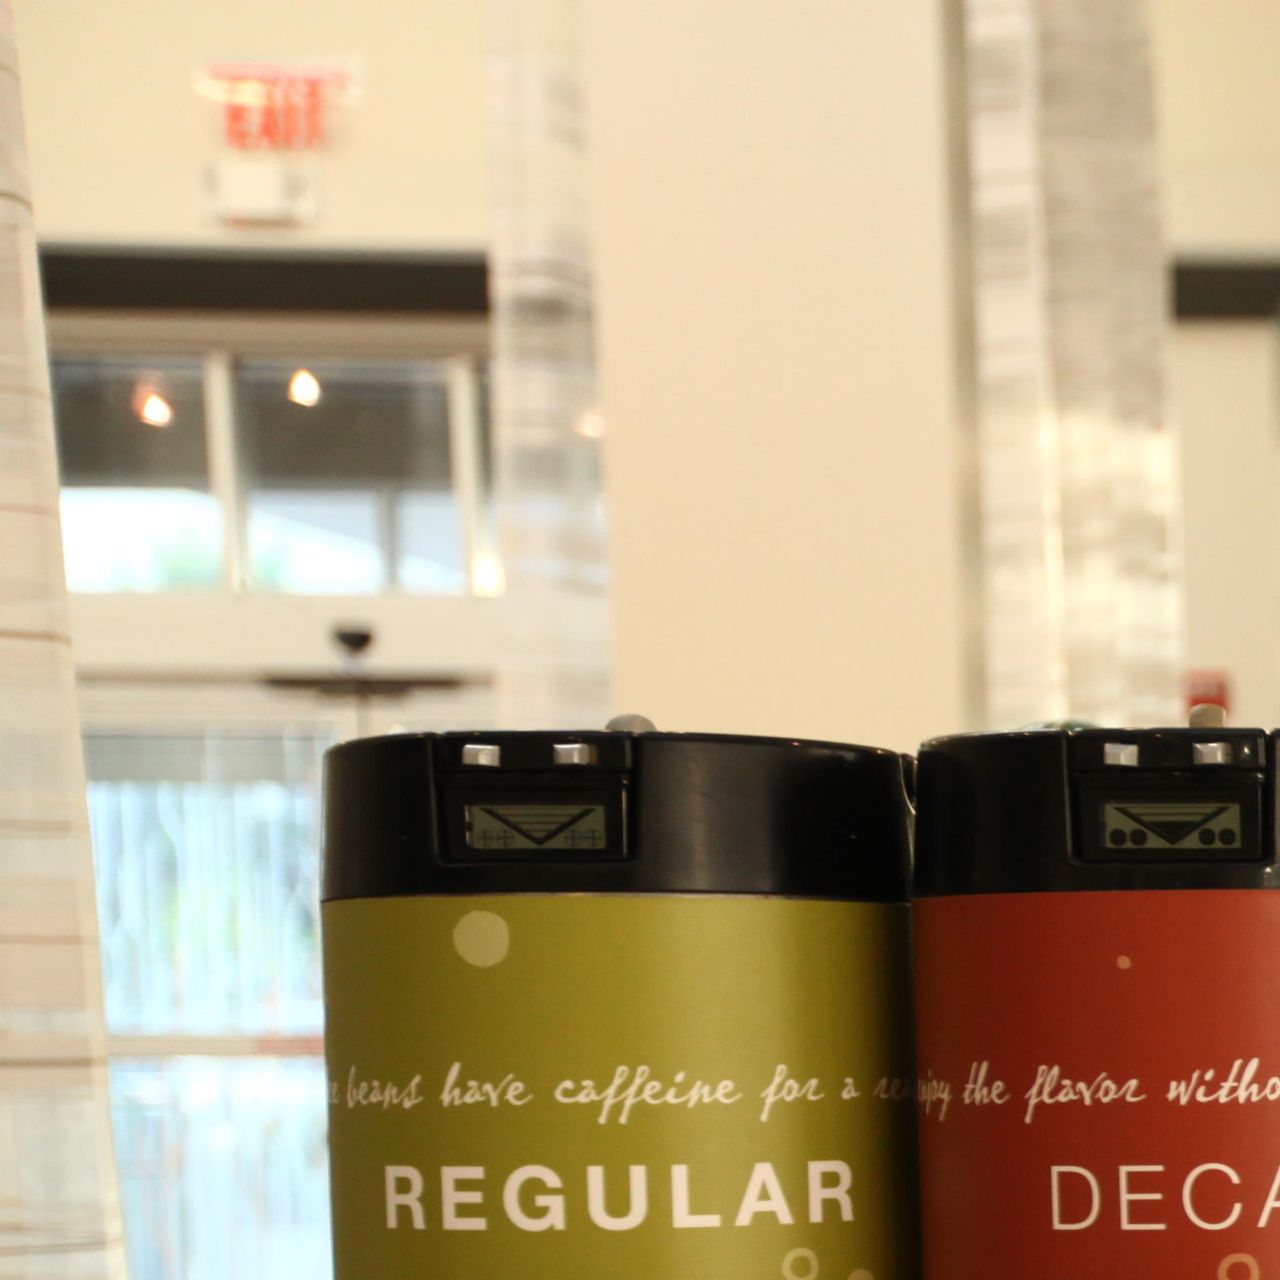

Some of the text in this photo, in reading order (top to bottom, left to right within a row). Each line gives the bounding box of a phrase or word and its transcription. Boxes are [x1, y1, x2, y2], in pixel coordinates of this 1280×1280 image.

[440, 1062, 533, 1107] have
[554, 1065, 741, 1125] caffeine
[759, 1064, 824, 1123] for
[840, 1076, 862, 1100] a
[961, 1060, 1012, 1106] the
[1024, 1065, 1146, 1124] flavor
[384, 1159, 855, 1231] REGULAR
